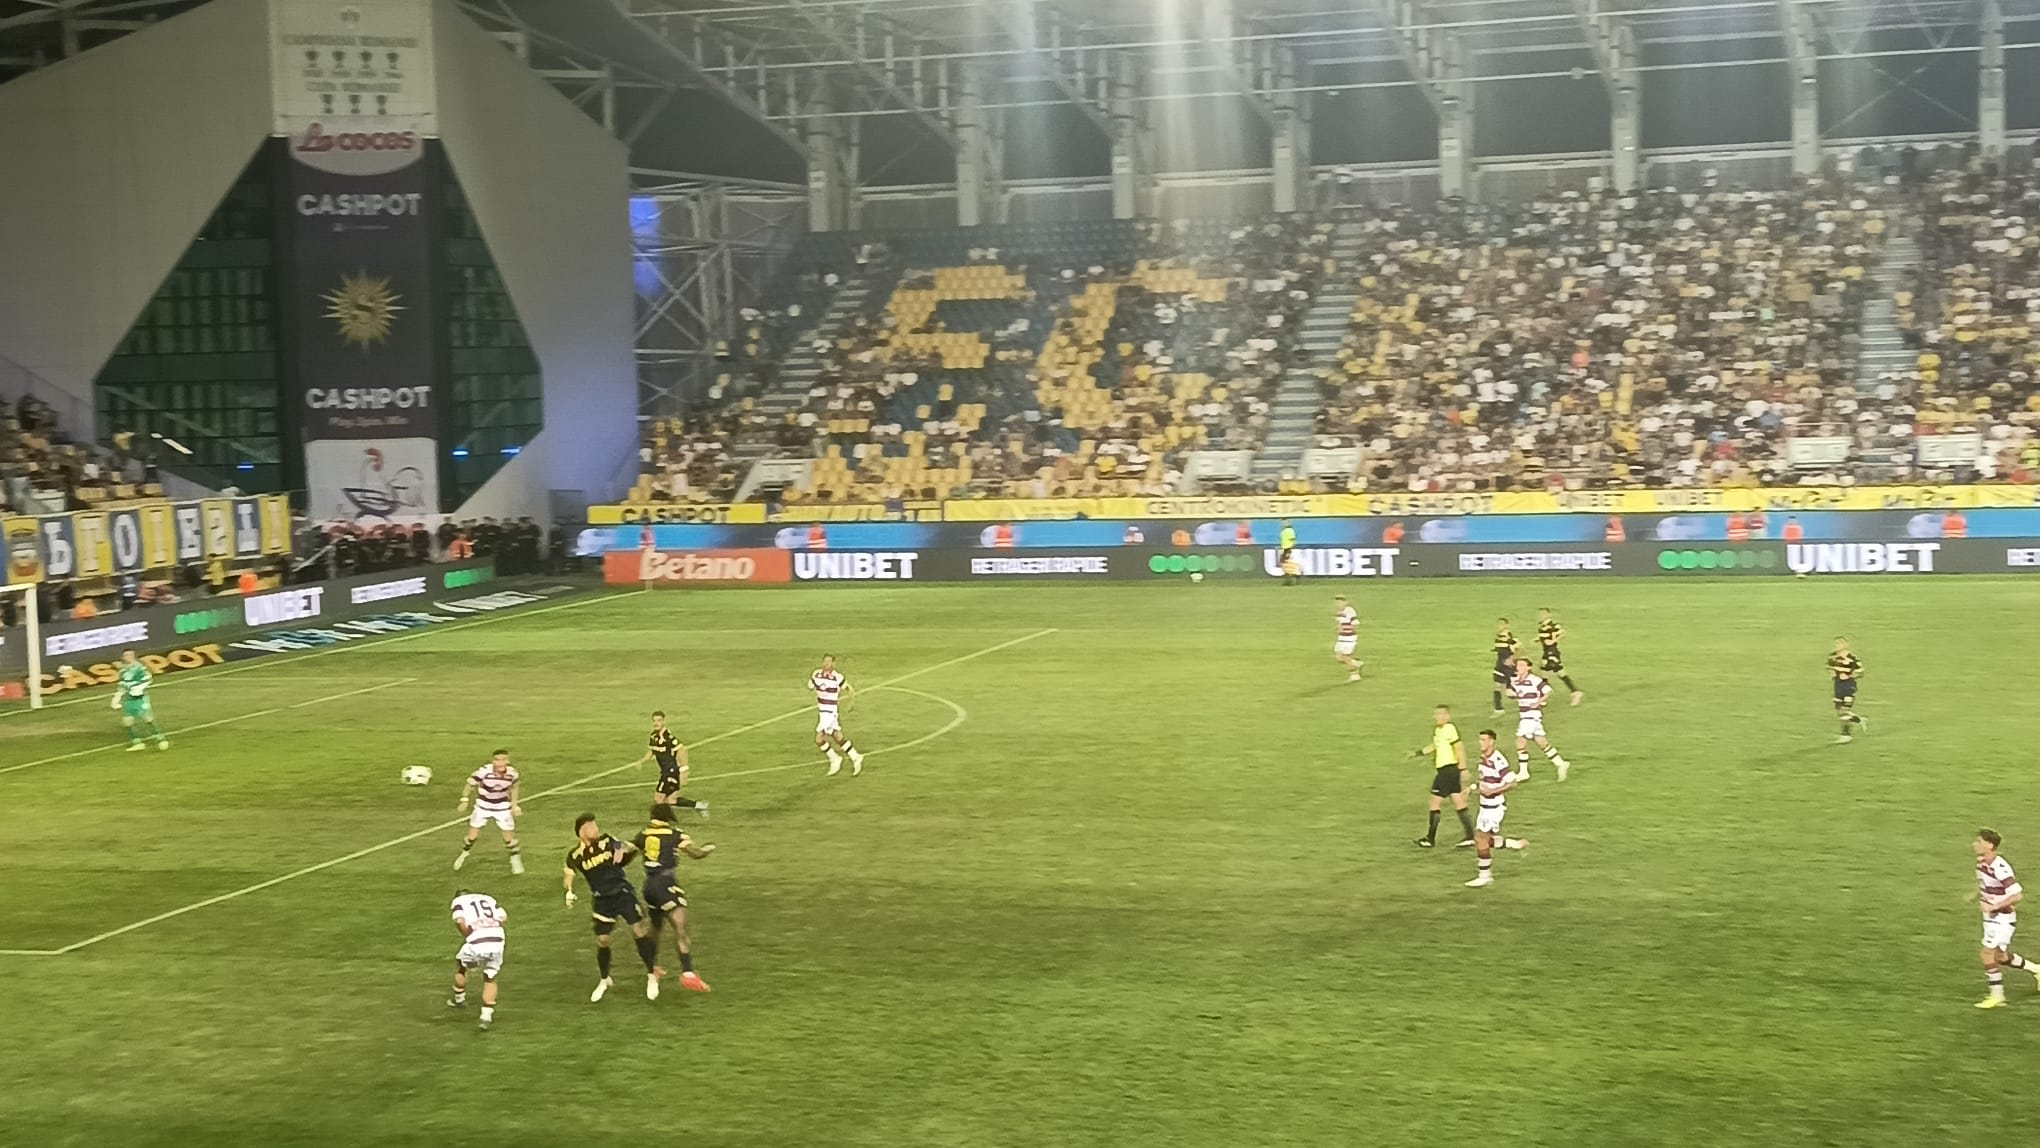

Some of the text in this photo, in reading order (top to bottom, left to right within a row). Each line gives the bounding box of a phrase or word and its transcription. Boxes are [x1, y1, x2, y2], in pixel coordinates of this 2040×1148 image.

[297, 193, 422, 216] CASHPOT
[305, 386, 431, 409] CASHPOT
[620, 506, 731, 524] CASHPOT
[638, 550, 756, 581] Betano
[793, 552, 918, 580] UNIBET
[1786, 542, 1940, 573] UNIBET
[26, 643, 224, 696] CASPOT
